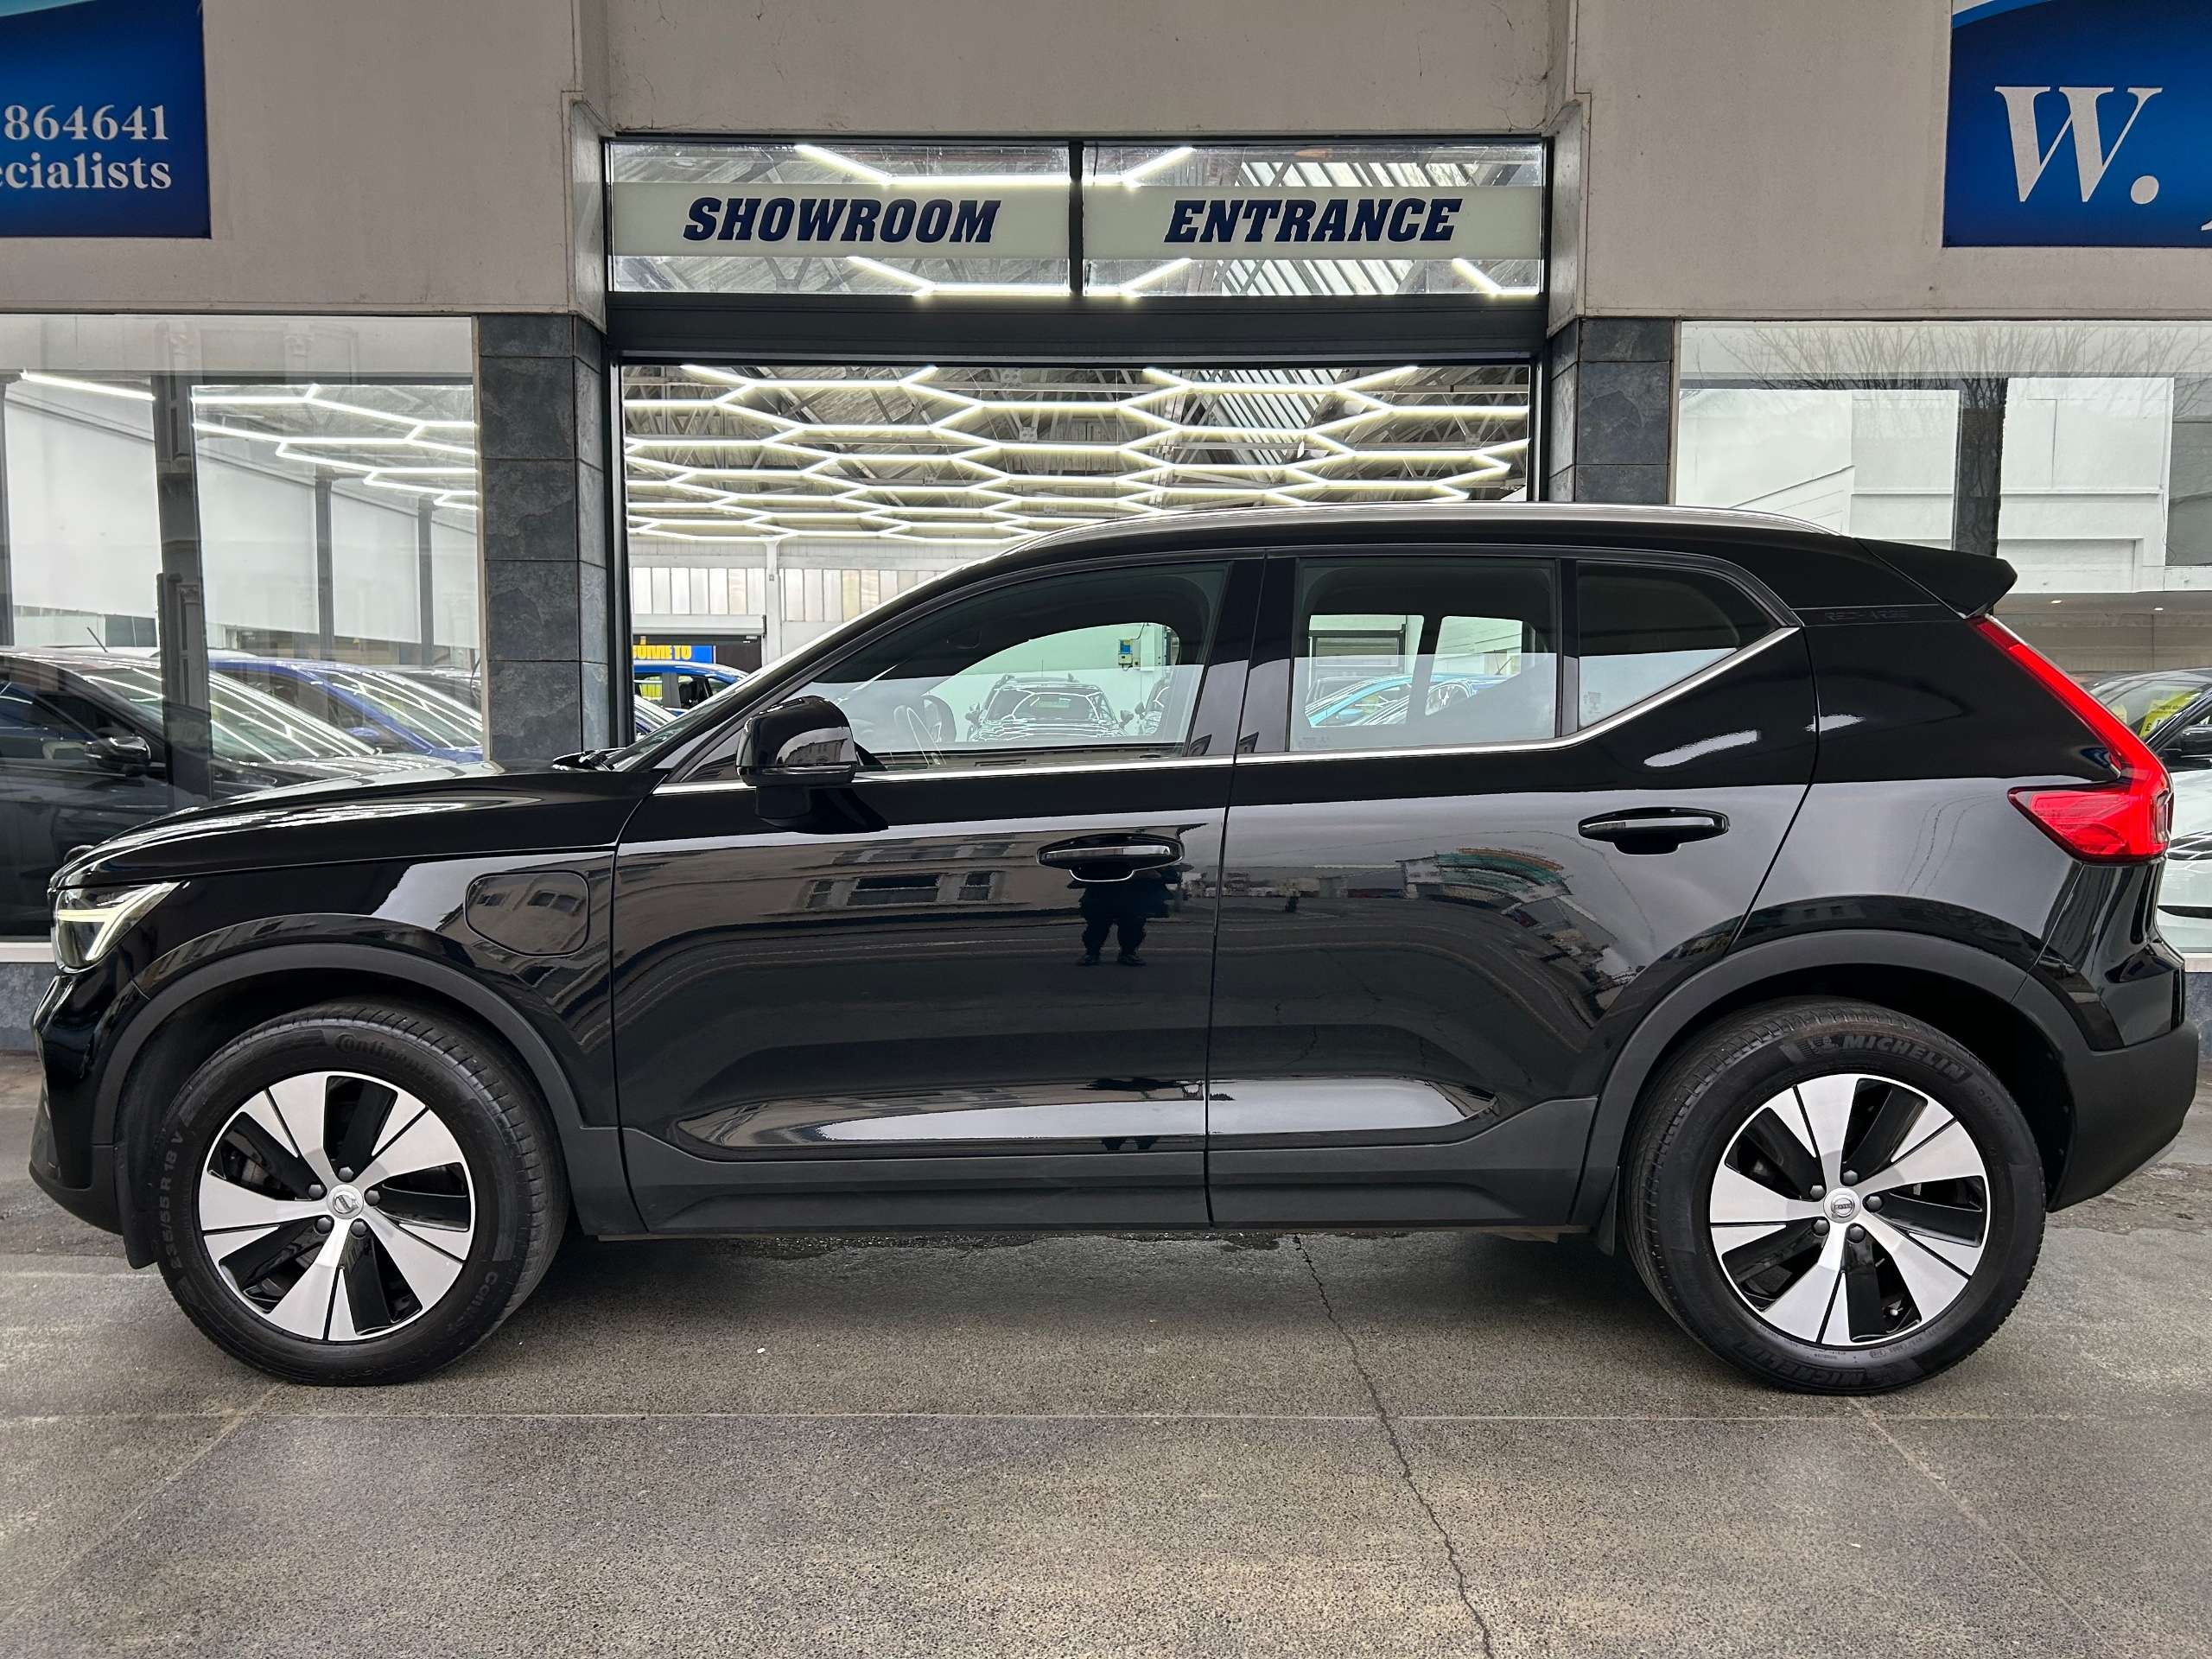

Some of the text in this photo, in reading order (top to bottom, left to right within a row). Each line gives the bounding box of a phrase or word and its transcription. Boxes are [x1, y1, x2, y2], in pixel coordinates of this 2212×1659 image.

[4, 105, 169, 141] 864641
[1994, 86, 2163, 205] W.
[0, 151, 172, 189] cialists
[683, 197, 1464, 245] SHOWROOM ENTRANCE
[673, 645, 692, 660] TO
[1841, 1034, 1969, 1082] MICHELIN
[159, 1176, 173, 1191] R
